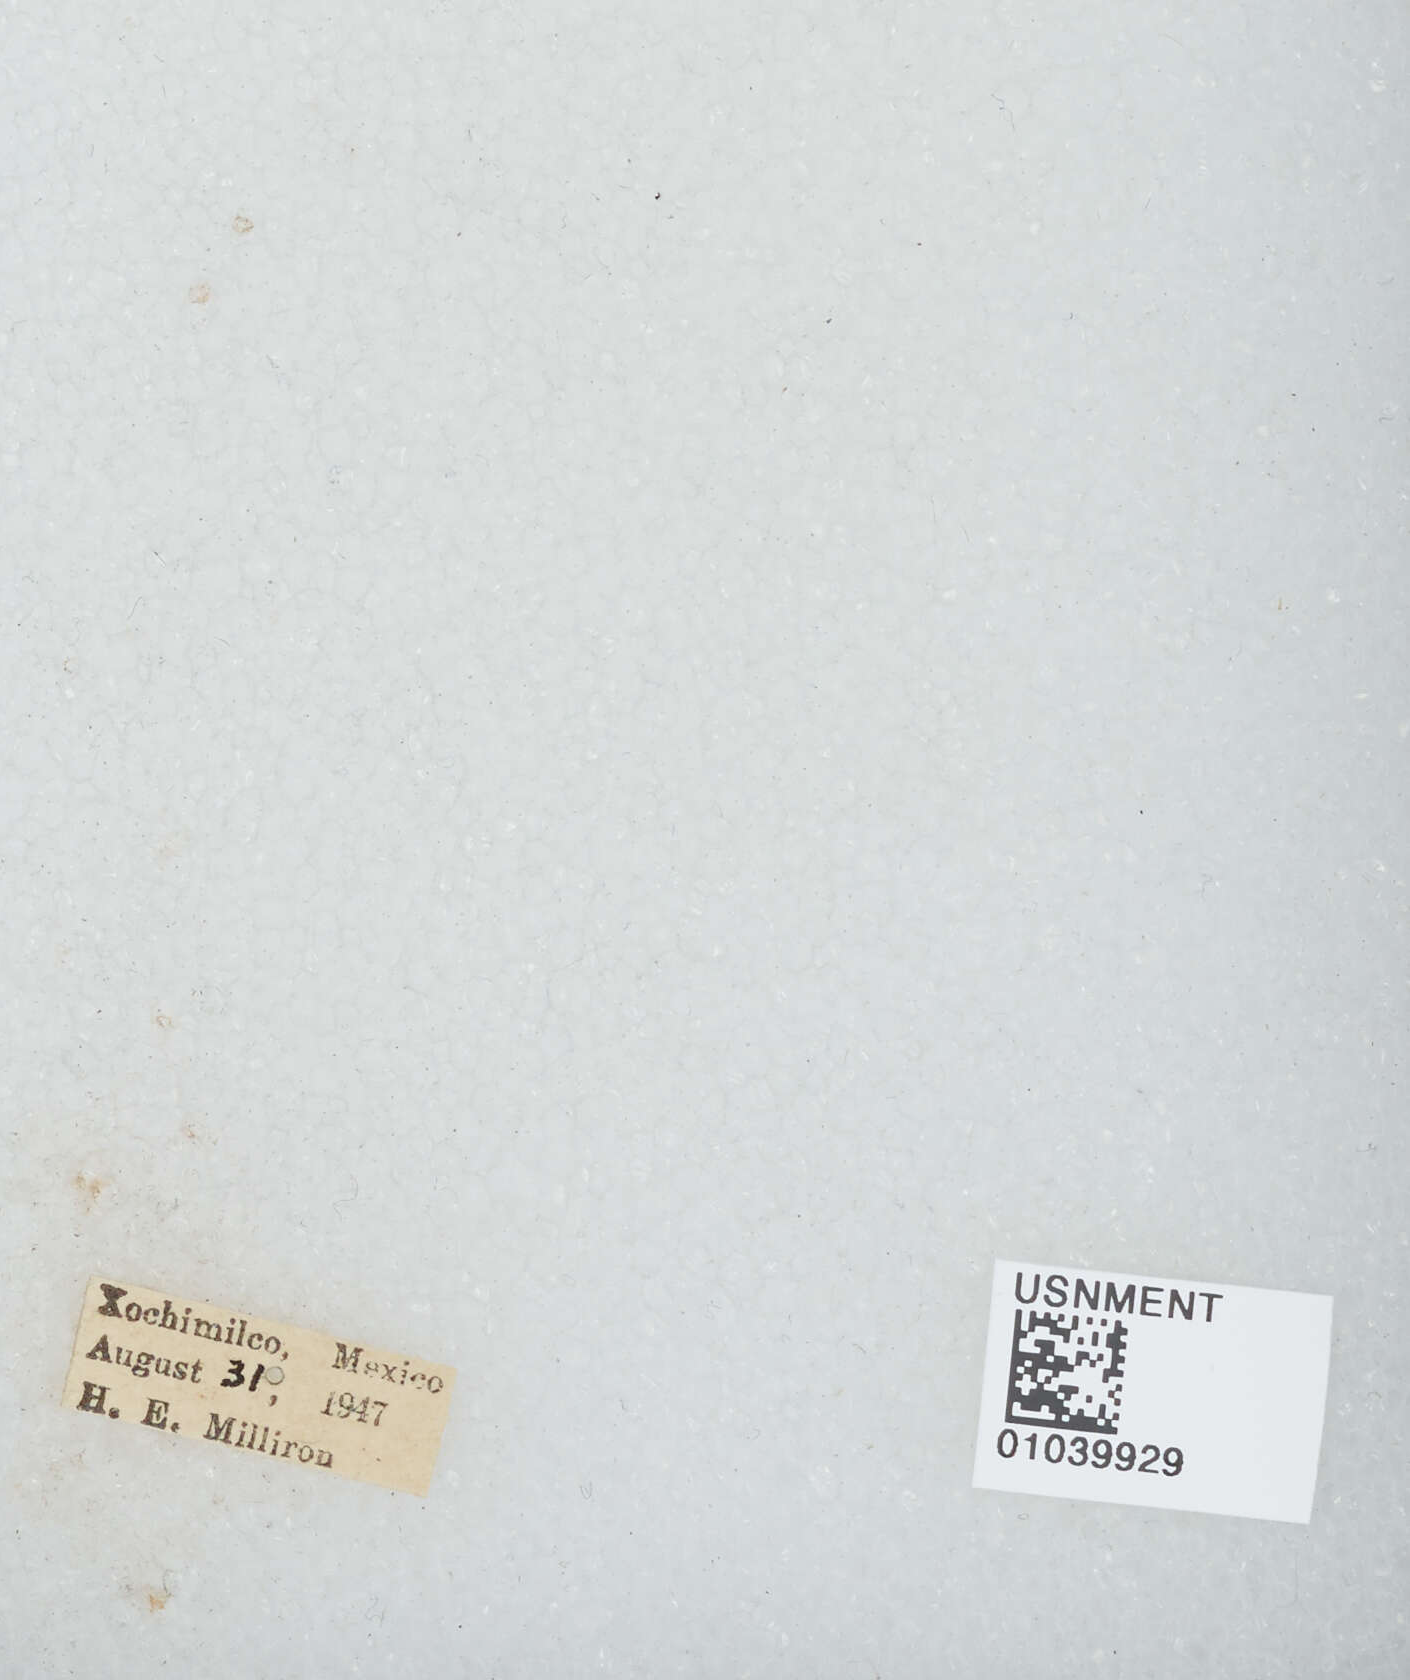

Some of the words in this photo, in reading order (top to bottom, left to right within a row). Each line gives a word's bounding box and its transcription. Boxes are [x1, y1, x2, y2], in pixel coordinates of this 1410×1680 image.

[98, 1283, 288, 1361] Xochimilco,
[332, 1343, 444, 1394] Mexico
[1015, 1272, 1223, 1322] USNMENT
[76, 1380, 120, 1419] H.
[140, 1398, 181, 1434] E.
[203, 1413, 333, 1469] Milliron
[86, 1335, 204, 1384] August
[321, 1391, 389, 1428] 1947
[997, 1428, 1184, 1477] 01039929
